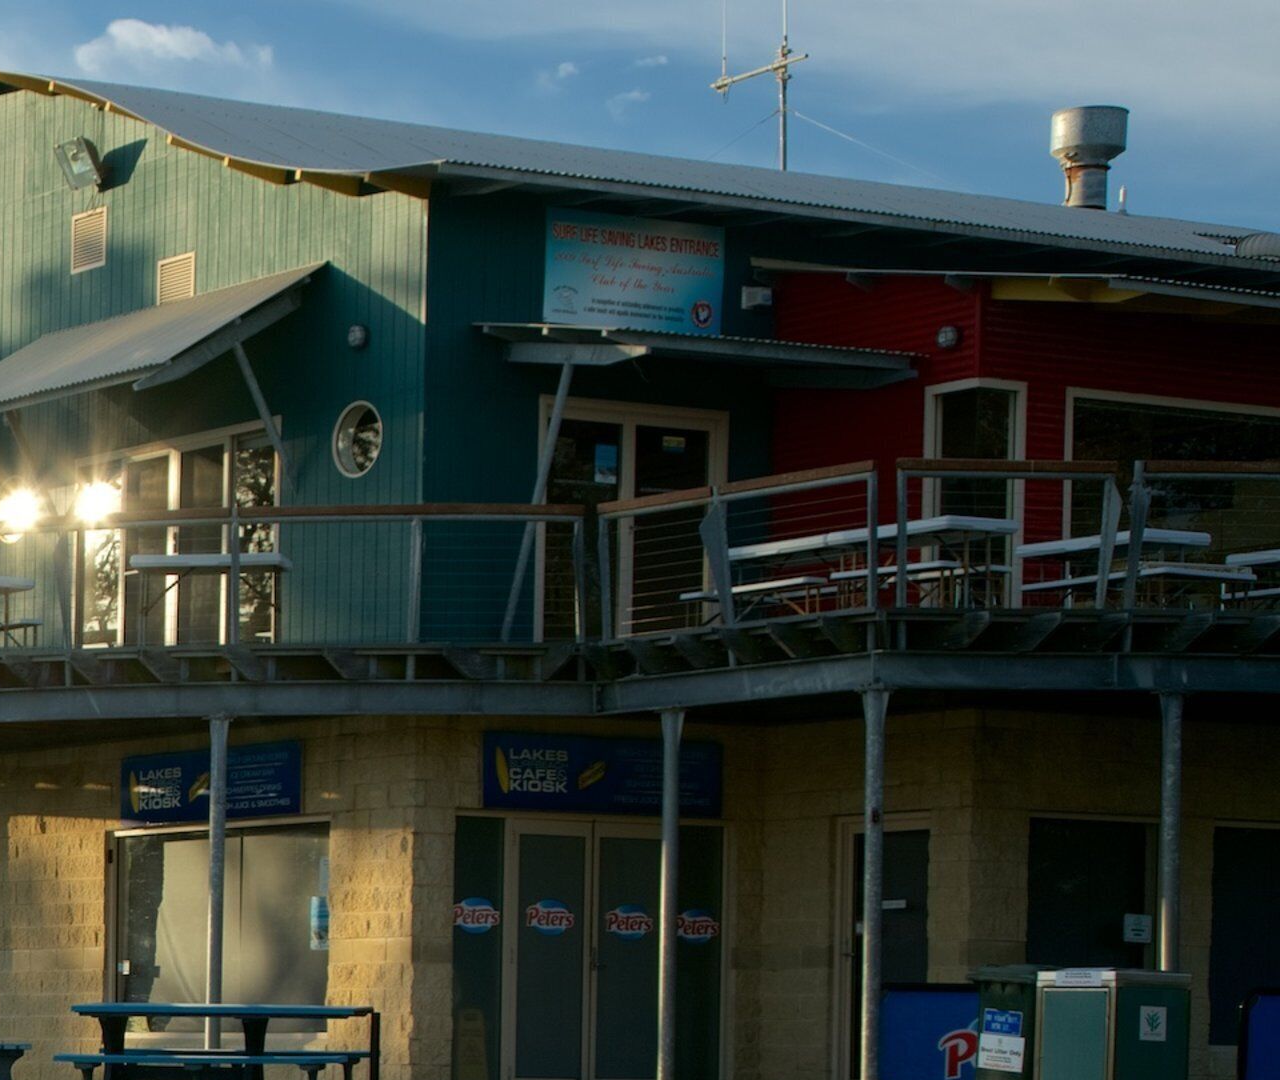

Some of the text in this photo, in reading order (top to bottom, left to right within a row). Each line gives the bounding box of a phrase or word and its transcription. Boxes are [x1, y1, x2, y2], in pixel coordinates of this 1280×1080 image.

[580, 227, 599, 243] LIFE
[601, 228, 636, 248] SAVING
[638, 233, 668, 252] LAKES
[670, 237, 720, 257] ENTRANCE
[509, 747, 568, 761] LAKES
[139, 766, 182, 781] LAKES
[509, 779, 568, 793] KIOSK
[139, 796, 182, 811] KIOSK
[454, 906, 500, 926] Peters
[527, 907, 574, 926] Peters
[607, 912, 652, 931] Peters
[677, 916, 720, 936] Peters
